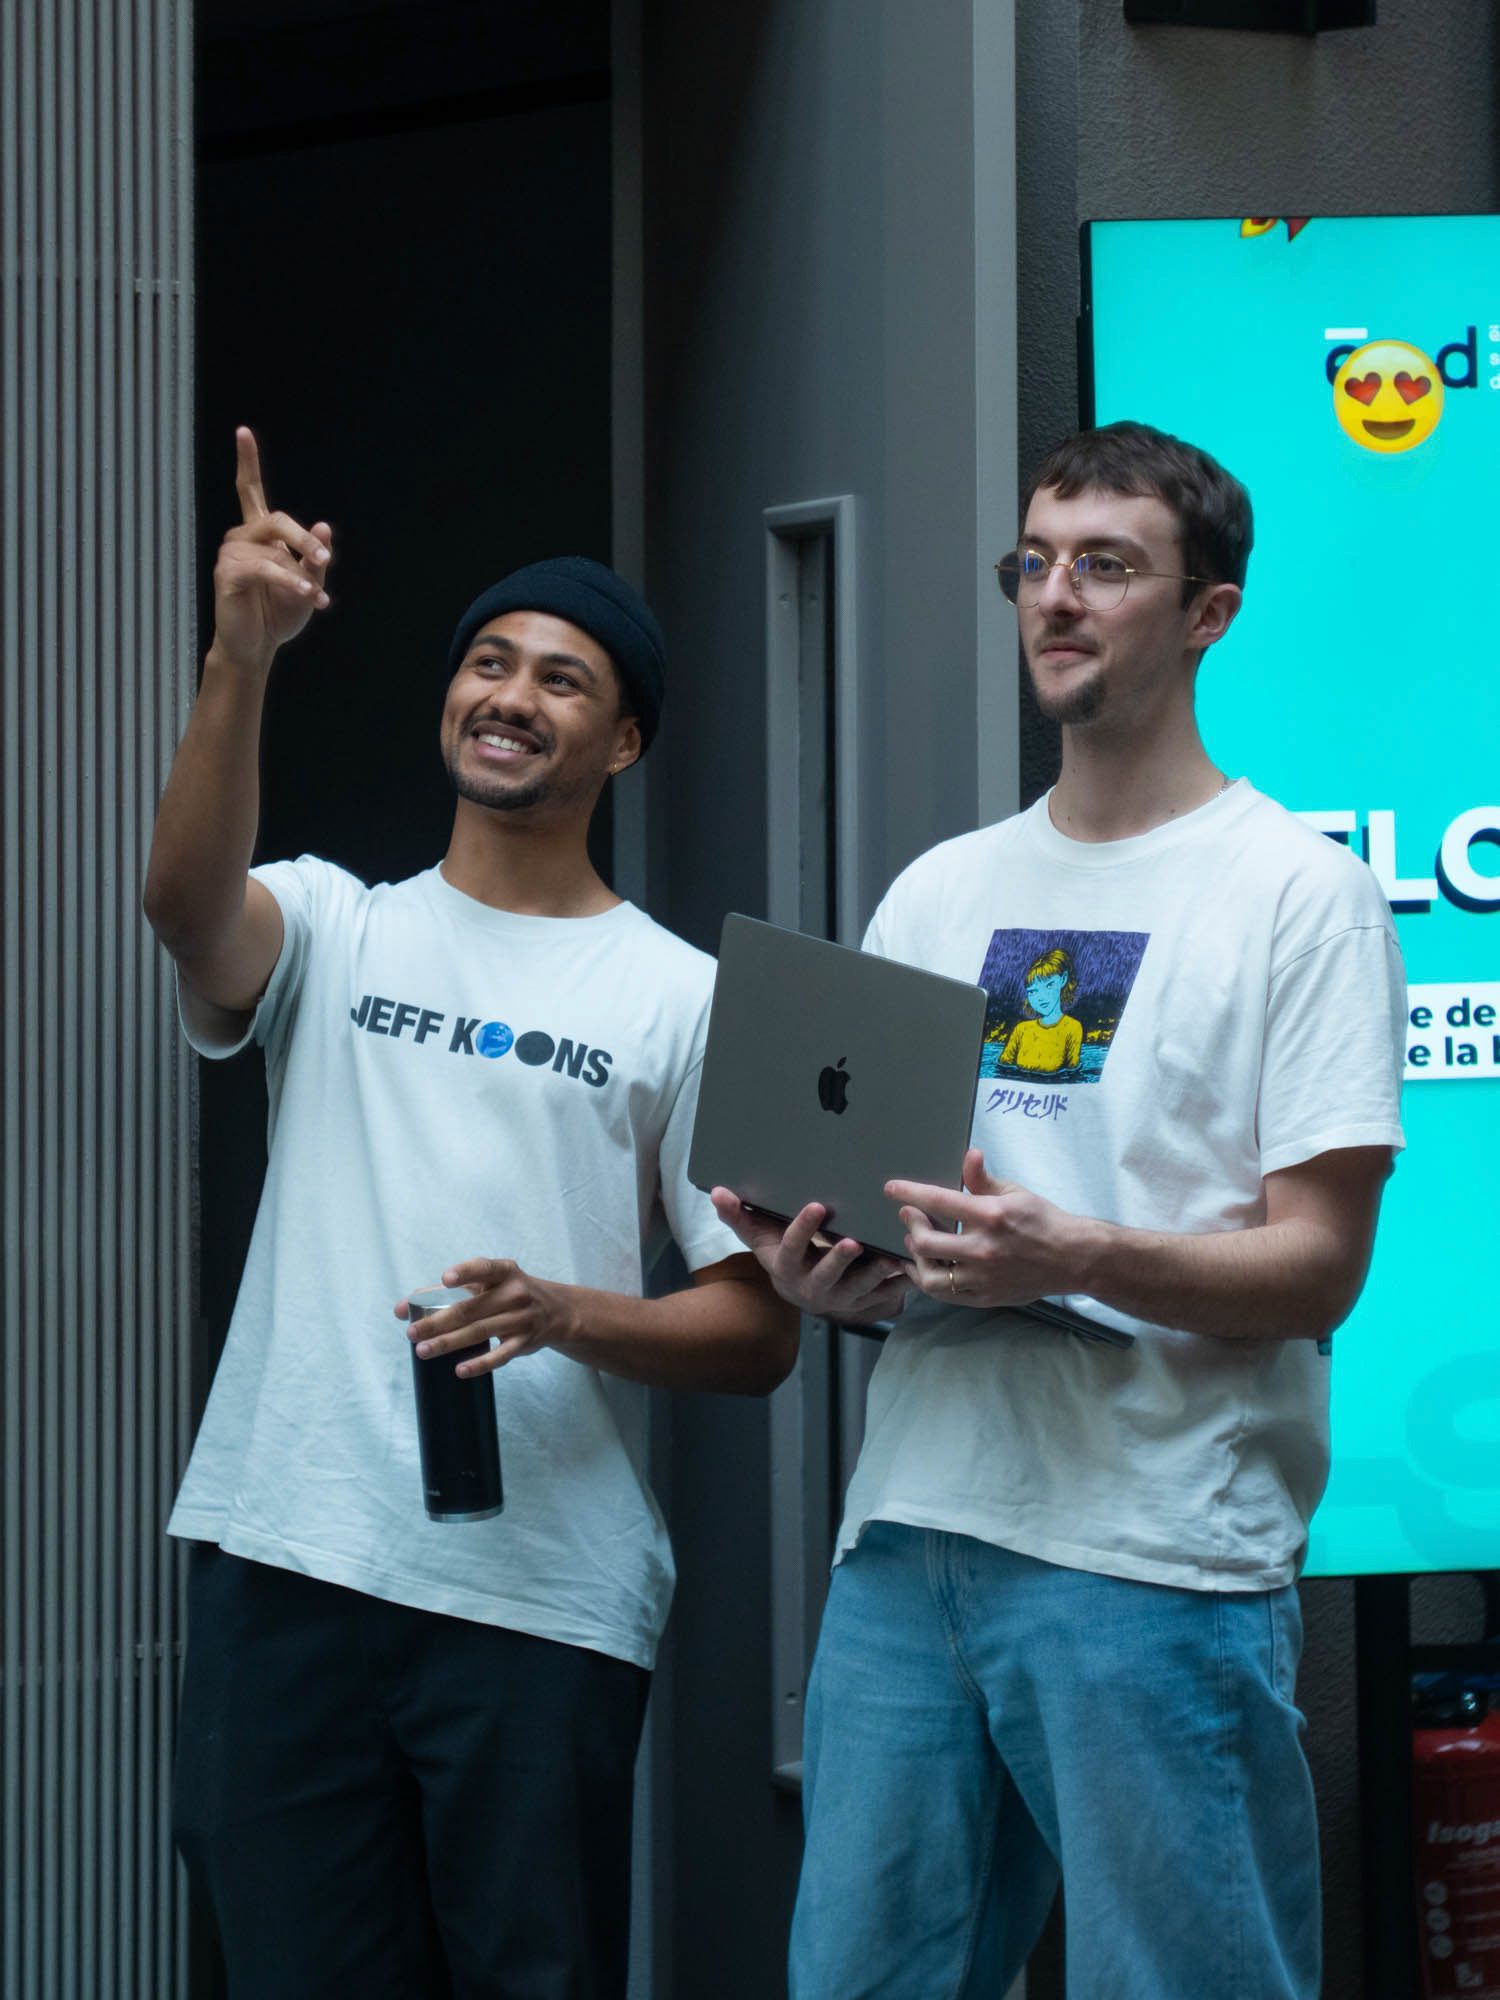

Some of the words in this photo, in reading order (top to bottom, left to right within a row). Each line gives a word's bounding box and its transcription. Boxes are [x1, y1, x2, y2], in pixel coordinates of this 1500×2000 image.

[350, 995, 445, 1044] JEFF
[1445, 1035, 1478, 1066] la
[985, 1088, 1068, 1121] グリセリド
